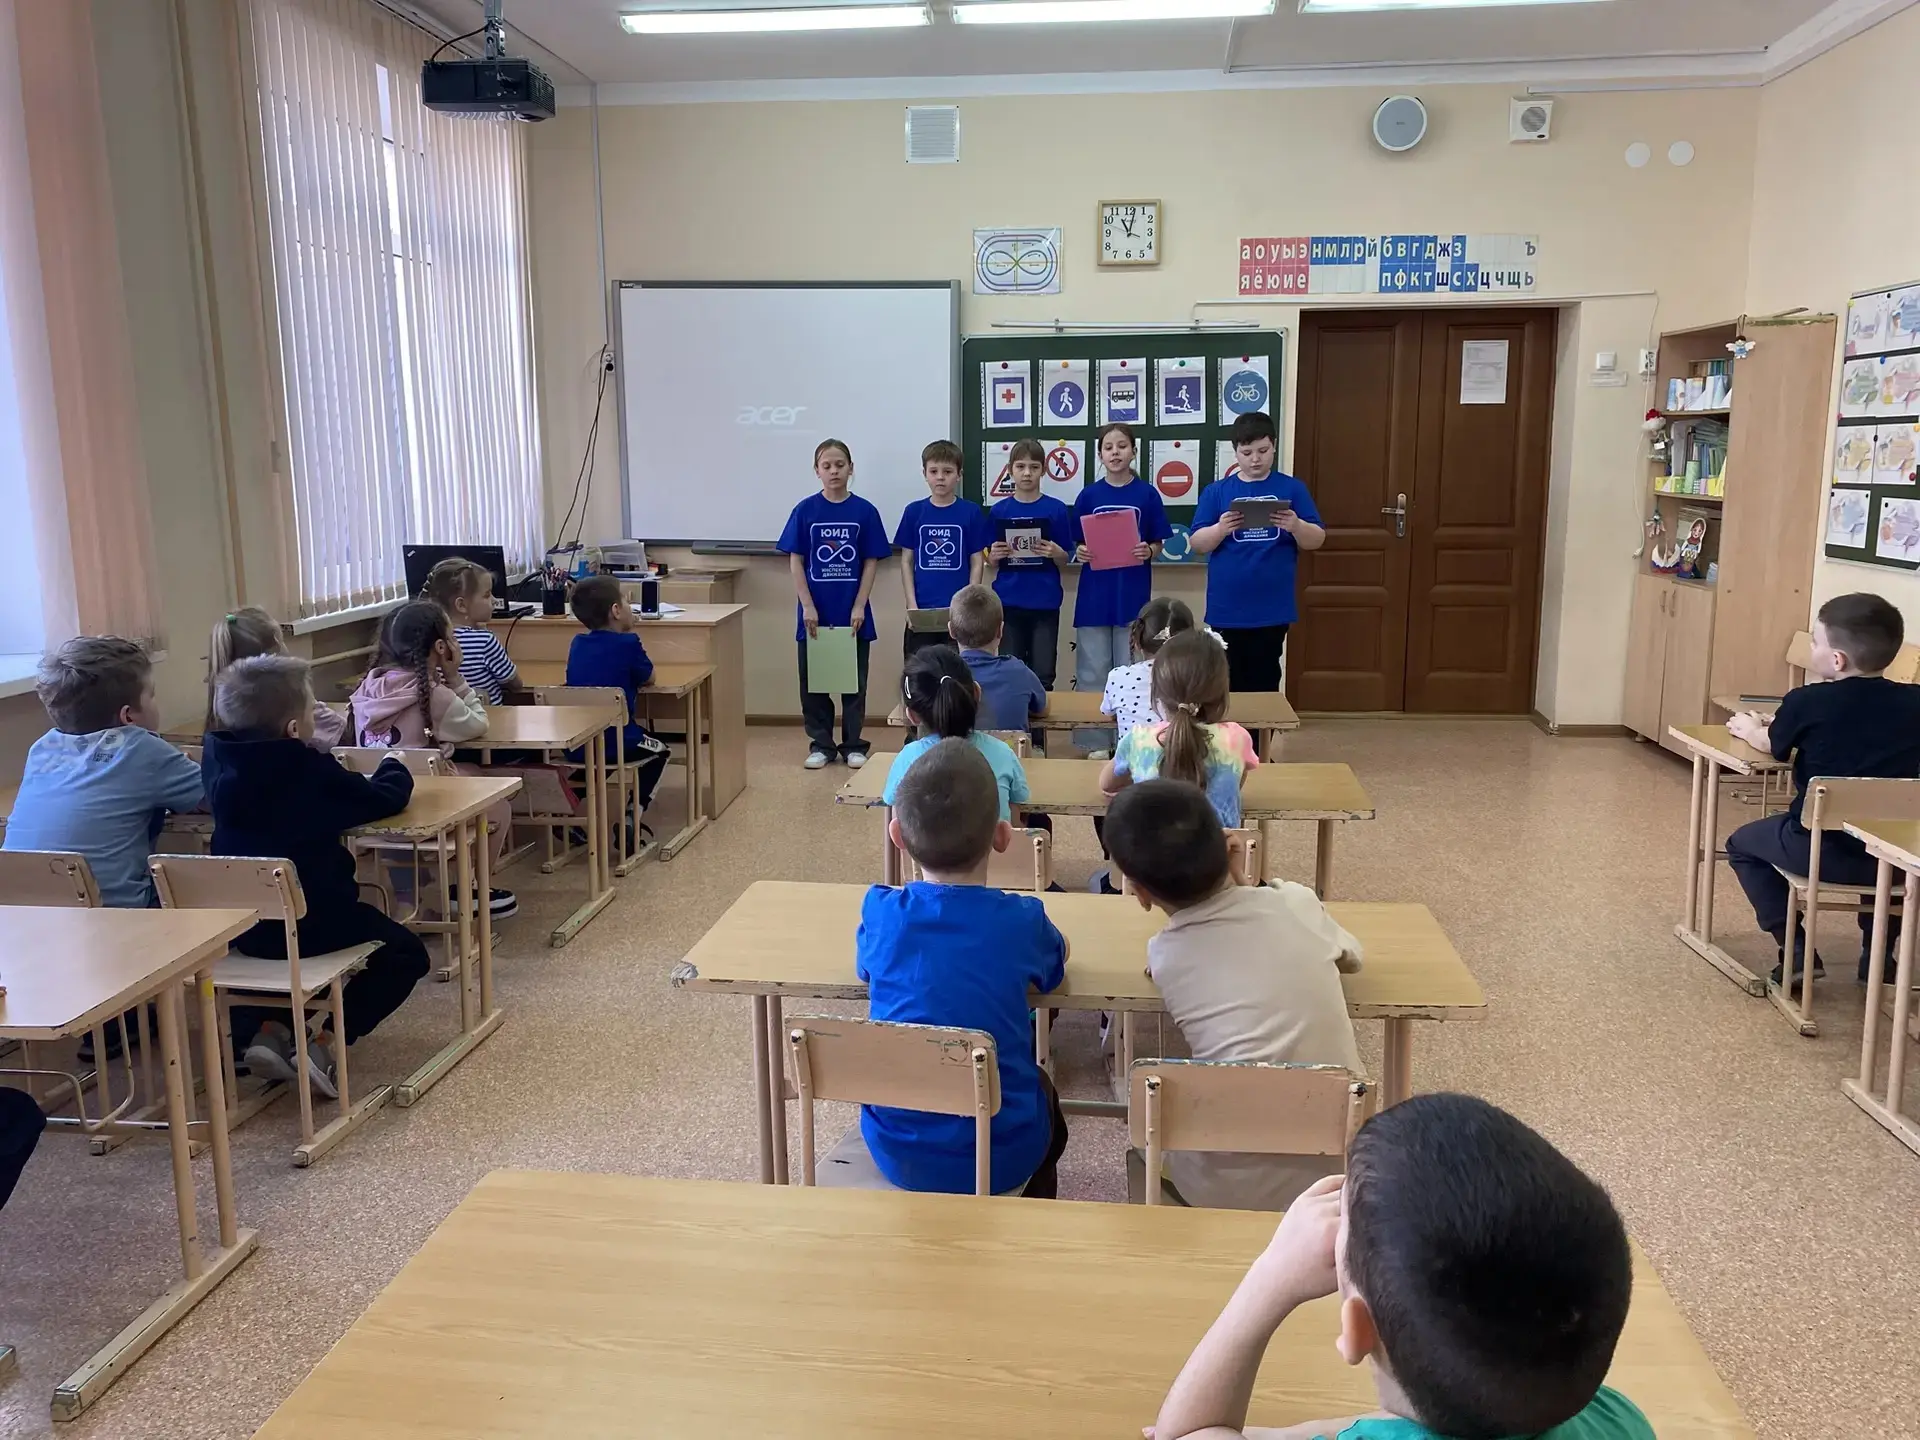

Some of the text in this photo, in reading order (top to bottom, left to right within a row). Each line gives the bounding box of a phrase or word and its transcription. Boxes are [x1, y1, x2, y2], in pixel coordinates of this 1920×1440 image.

[1110, 207, 1119, 215] 11
[1142, 206, 1146, 215] 1
[1104, 216, 1114, 224] 10
[1148, 215, 1153, 223] 2
[1105, 229, 1111, 237] 9
[1147, 228, 1153, 236] 3
[1105, 242, 1111, 251] 8
[1147, 241, 1152, 250] 4
[1113, 250, 1118, 259] 7
[1126, 250, 1131, 258] 6
[1139, 250, 1145, 258] 5
[736, 406, 808, 425] acer
[821, 528, 850, 539] ЮИД
[928, 529, 951, 537] ЮИД
